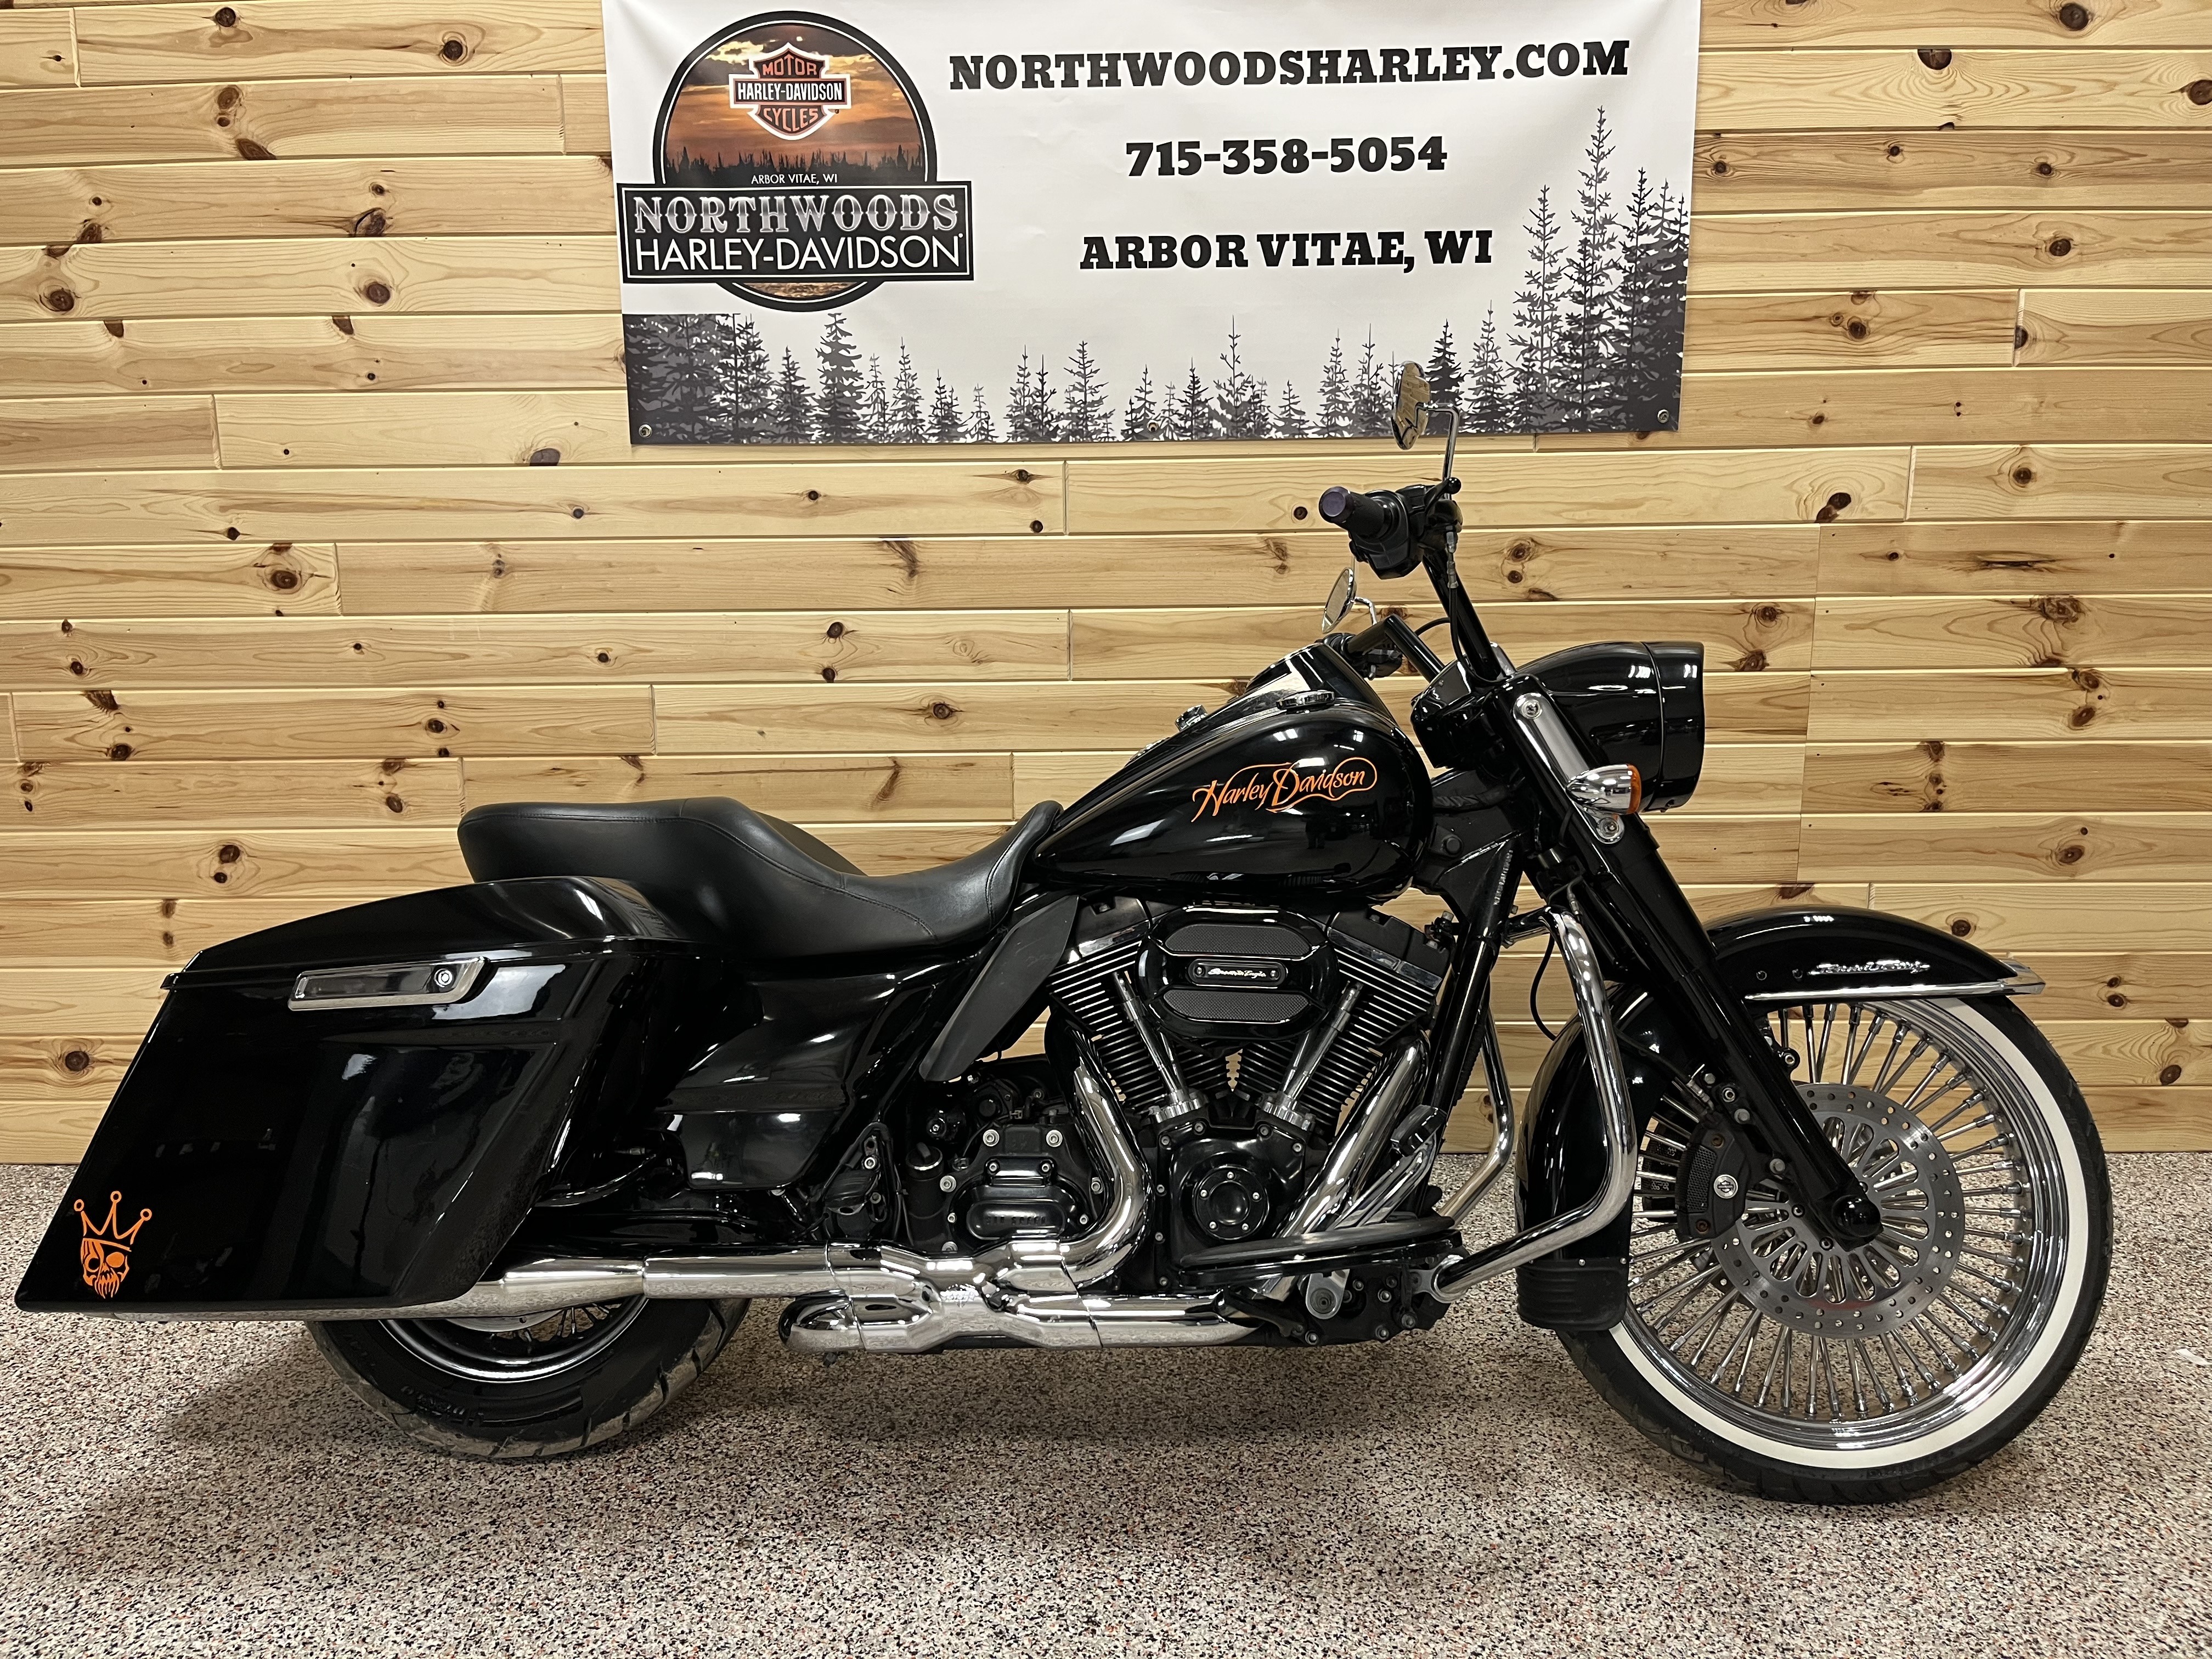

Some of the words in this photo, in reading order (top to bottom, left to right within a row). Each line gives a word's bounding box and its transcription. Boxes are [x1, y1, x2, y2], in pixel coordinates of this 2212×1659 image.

[763, 53, 817, 76] MOTOR
[950, 41, 1629, 90] NORTHWOODSHARLEY.COM
[738, 83, 842, 100] HARLEY-DAVIDSON
[763, 108, 819, 132] CYCLES
[1126, 136, 1448, 177] 715-358-5054
[751, 174, 785, 184] ARBOR
[788, 173, 820, 185] VITAE,
[822, 173, 838, 183] WI
[634, 194, 959, 234] NORTHWOODS
[636, 235, 960, 270] HARLEY-DAVIDSON
[1080, 235, 1249, 270] ARBOR
[1256, 230, 1415, 274] VITAE,
[1424, 230, 1493, 264] WI
[1191, 764, 1274, 822] Harley
[1265, 757, 1377, 813] Davidson
